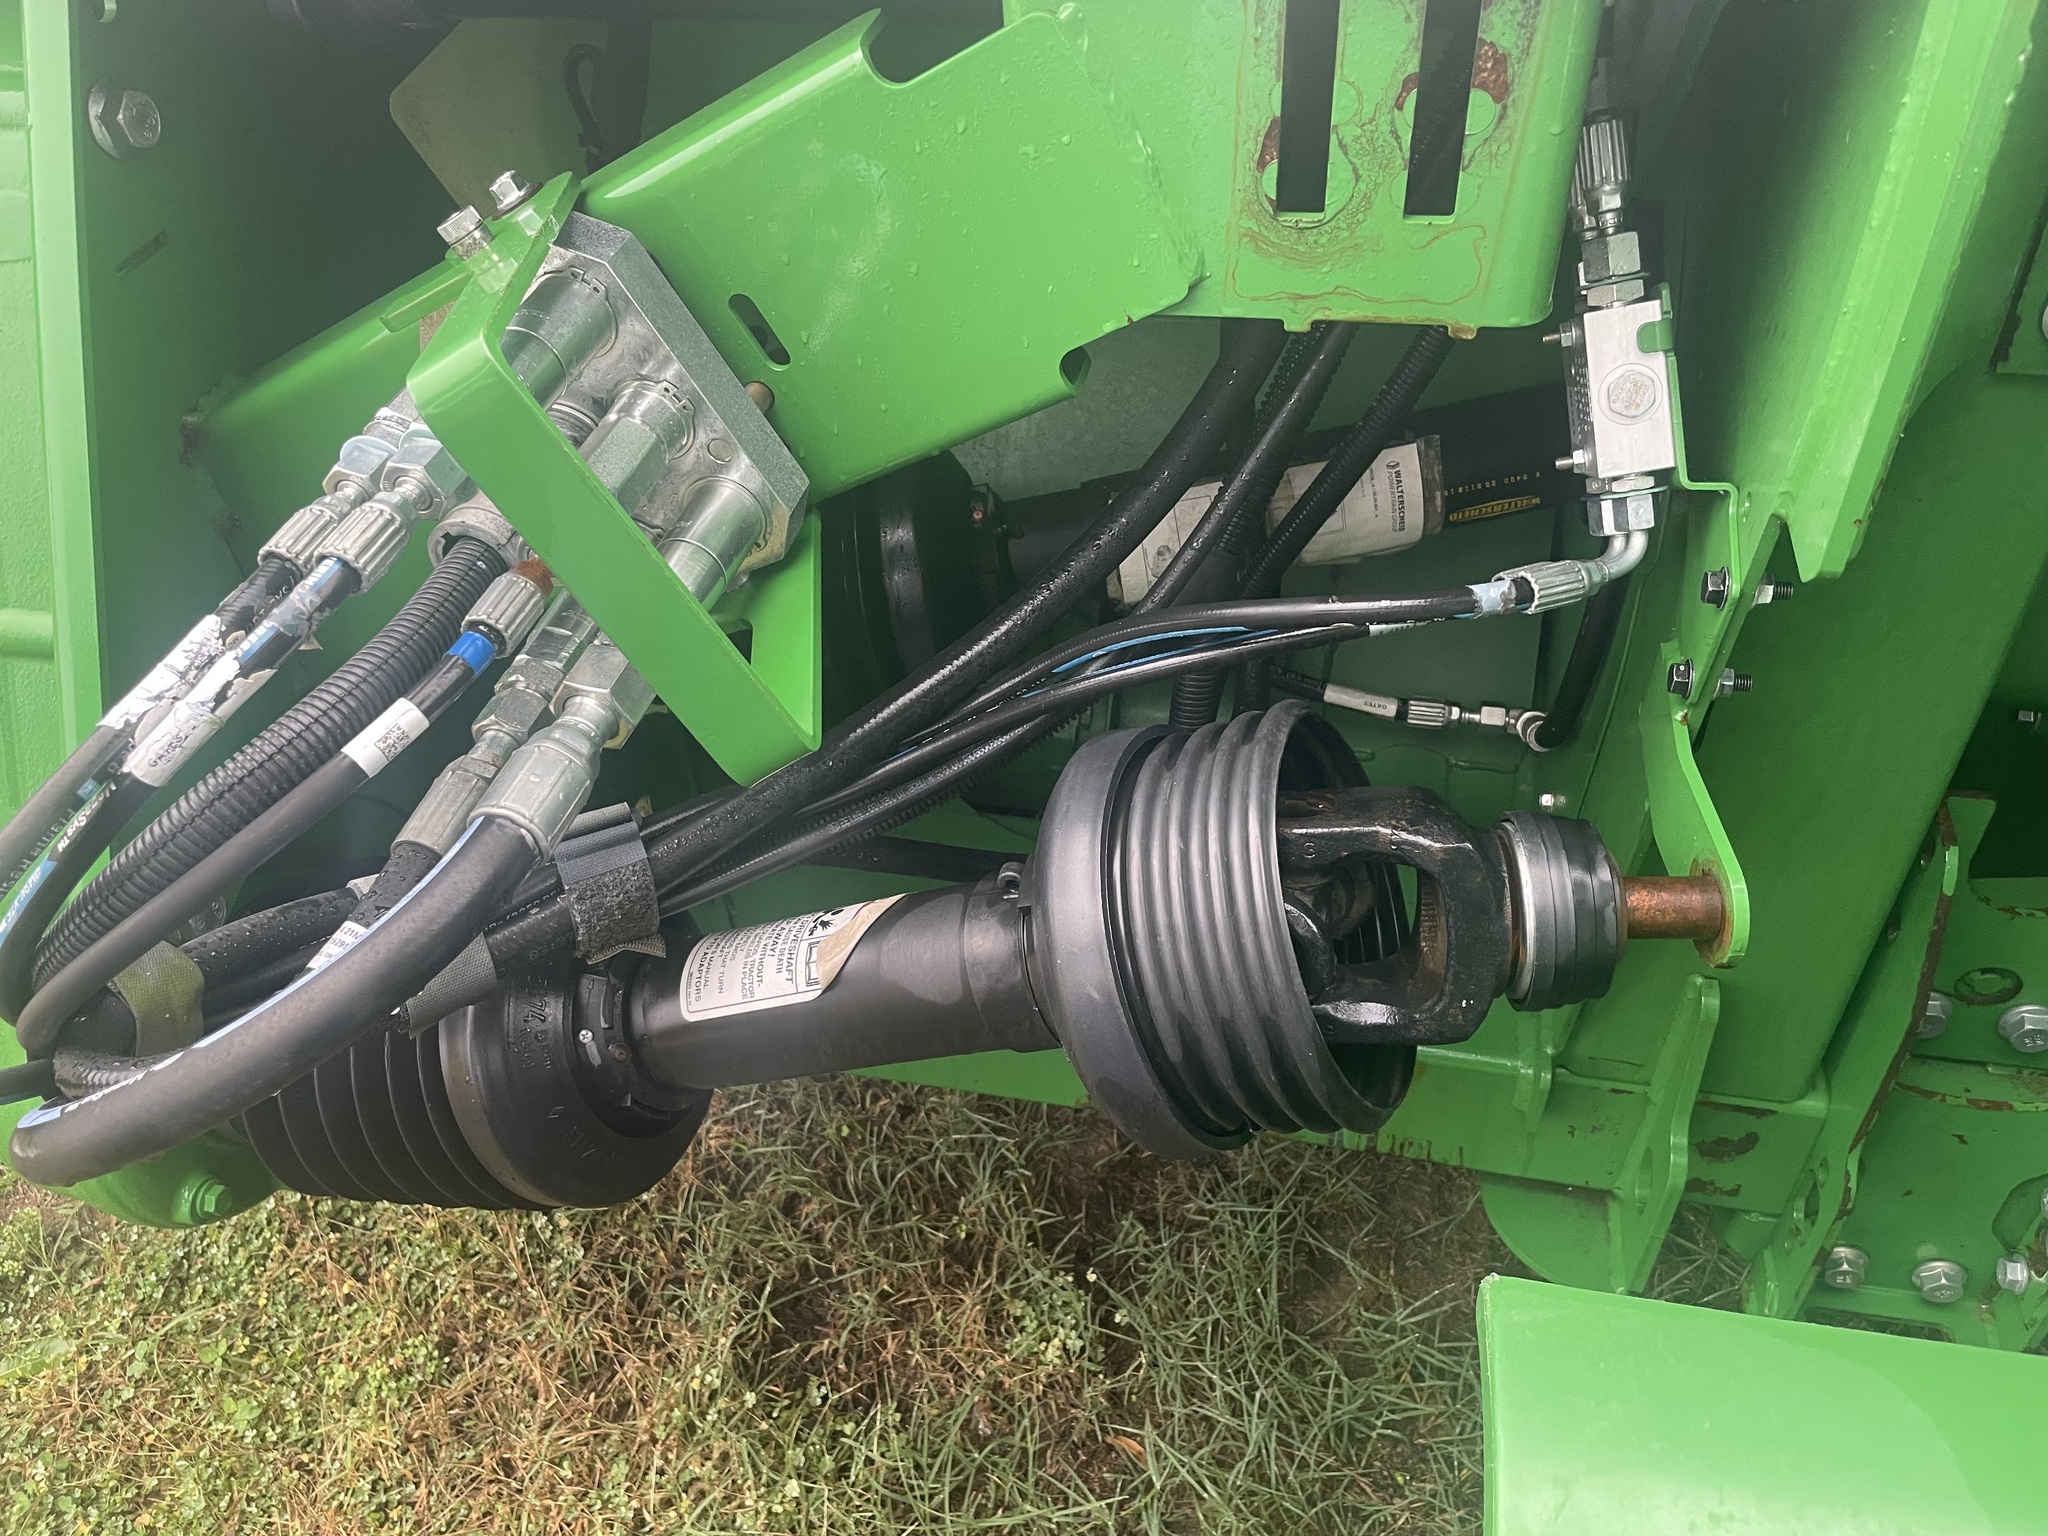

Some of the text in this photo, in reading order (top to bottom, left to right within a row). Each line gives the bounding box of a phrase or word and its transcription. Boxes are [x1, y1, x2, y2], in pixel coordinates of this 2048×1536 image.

[1387, 470, 1398, 514] POWERTRAIN
[1394, 469, 1406, 532] WALTERSCHEID
[1449, 496, 1541, 521] WALTERSCHEID
[720, 949, 731, 969] THAT
[767, 926, 786, 958] AWAY!
[776, 946, 787, 975] DEATH
[785, 919, 809, 985] DRIVESHAFT
[695, 937, 720, 1002] PTO ADAPTORS
[703, 955, 715, 990] MANUAL
[747, 958, 757, 999] TRACTOR
[756, 941, 771, 988] WITHOUT-
[741, 971, 749, 1001] PLACE
